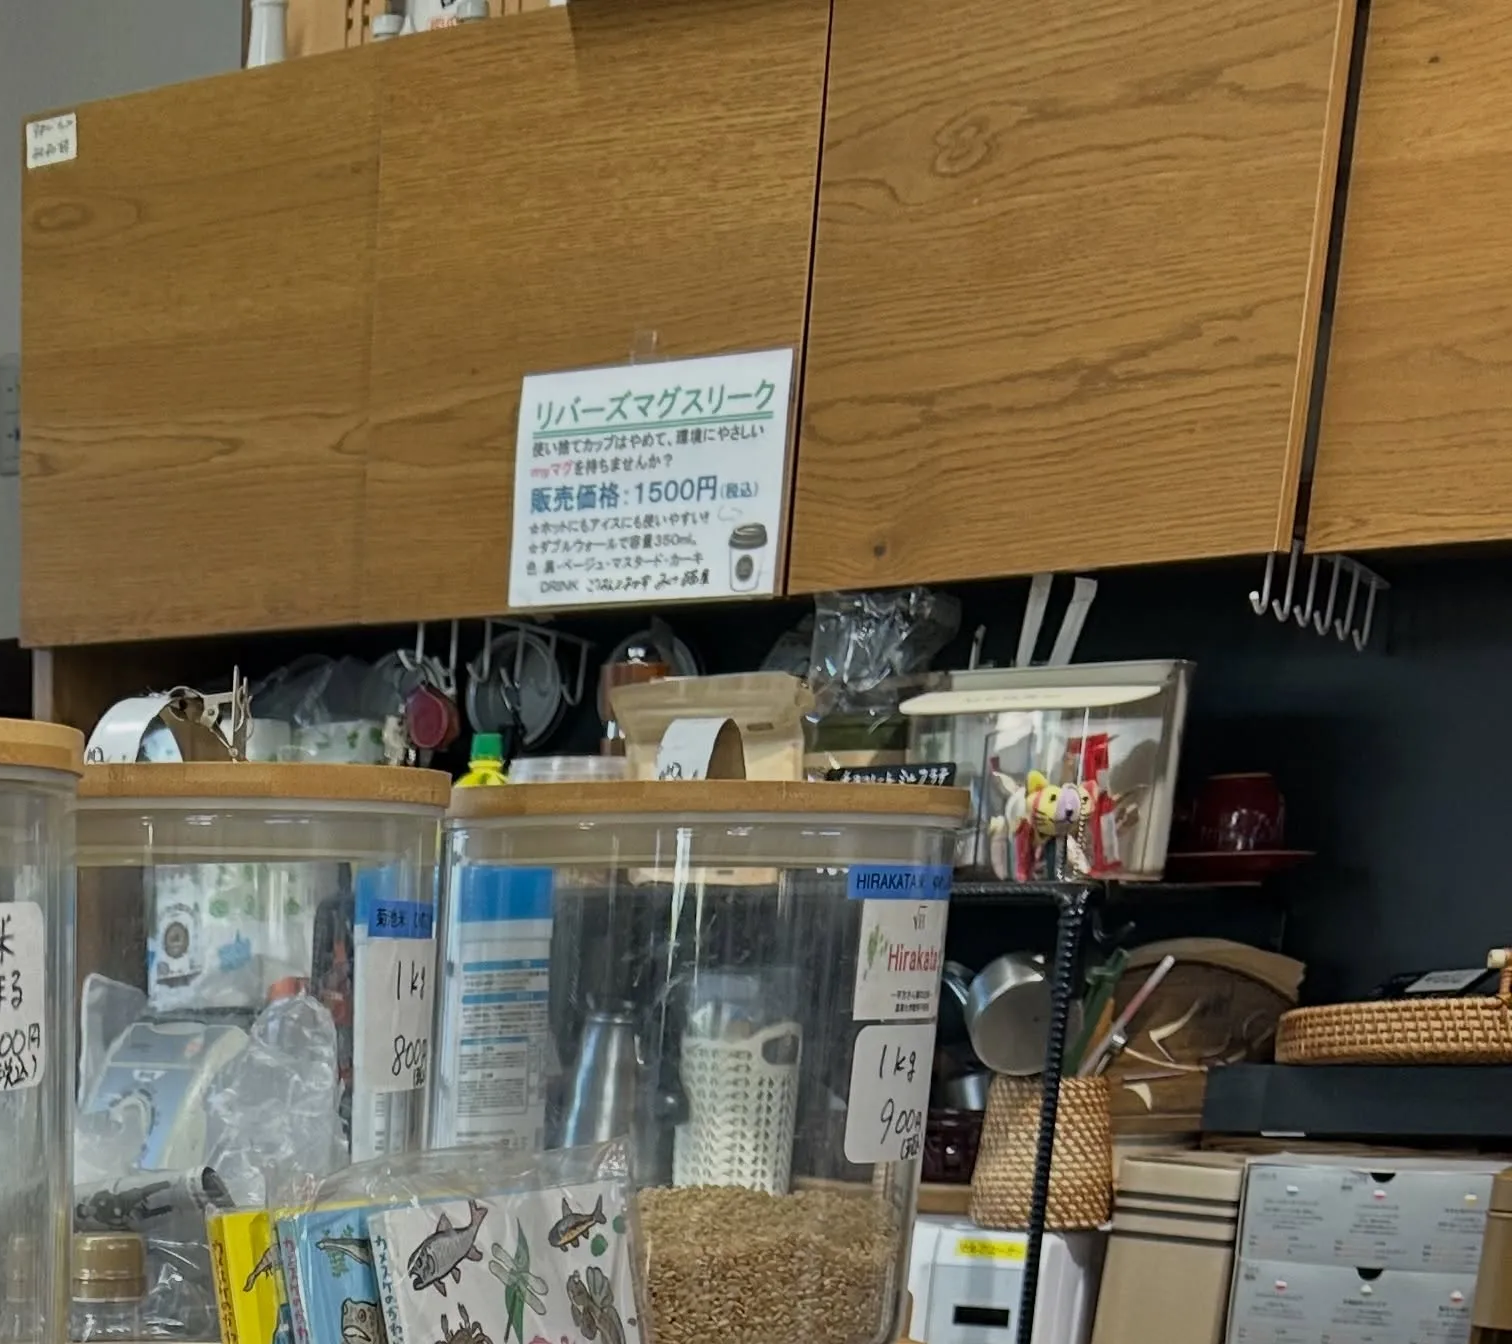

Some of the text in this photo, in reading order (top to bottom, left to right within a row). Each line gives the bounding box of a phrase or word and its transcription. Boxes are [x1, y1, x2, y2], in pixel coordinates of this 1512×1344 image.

[536, 379, 776, 430] リバーズマグスリーク
[532, 424, 765, 458] 使い捨てカップはやめて、環境にやさしい
